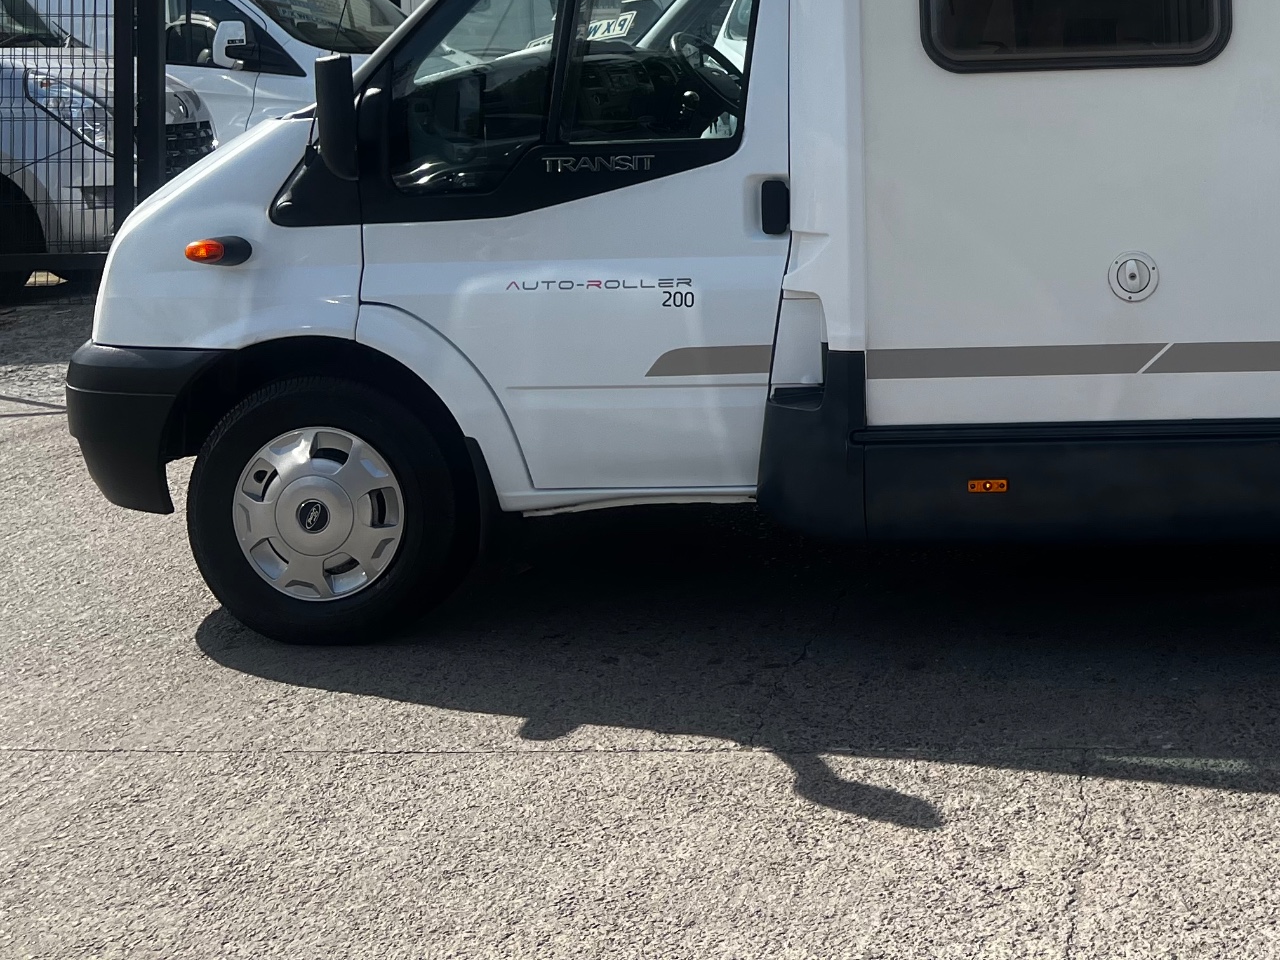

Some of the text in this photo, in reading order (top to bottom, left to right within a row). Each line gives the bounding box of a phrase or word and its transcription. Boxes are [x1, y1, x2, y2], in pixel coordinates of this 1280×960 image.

[541, 155, 655, 172] TRANSIT
[506, 278, 692, 290] AUTO-ROLLER
[662, 291, 694, 307] 200
